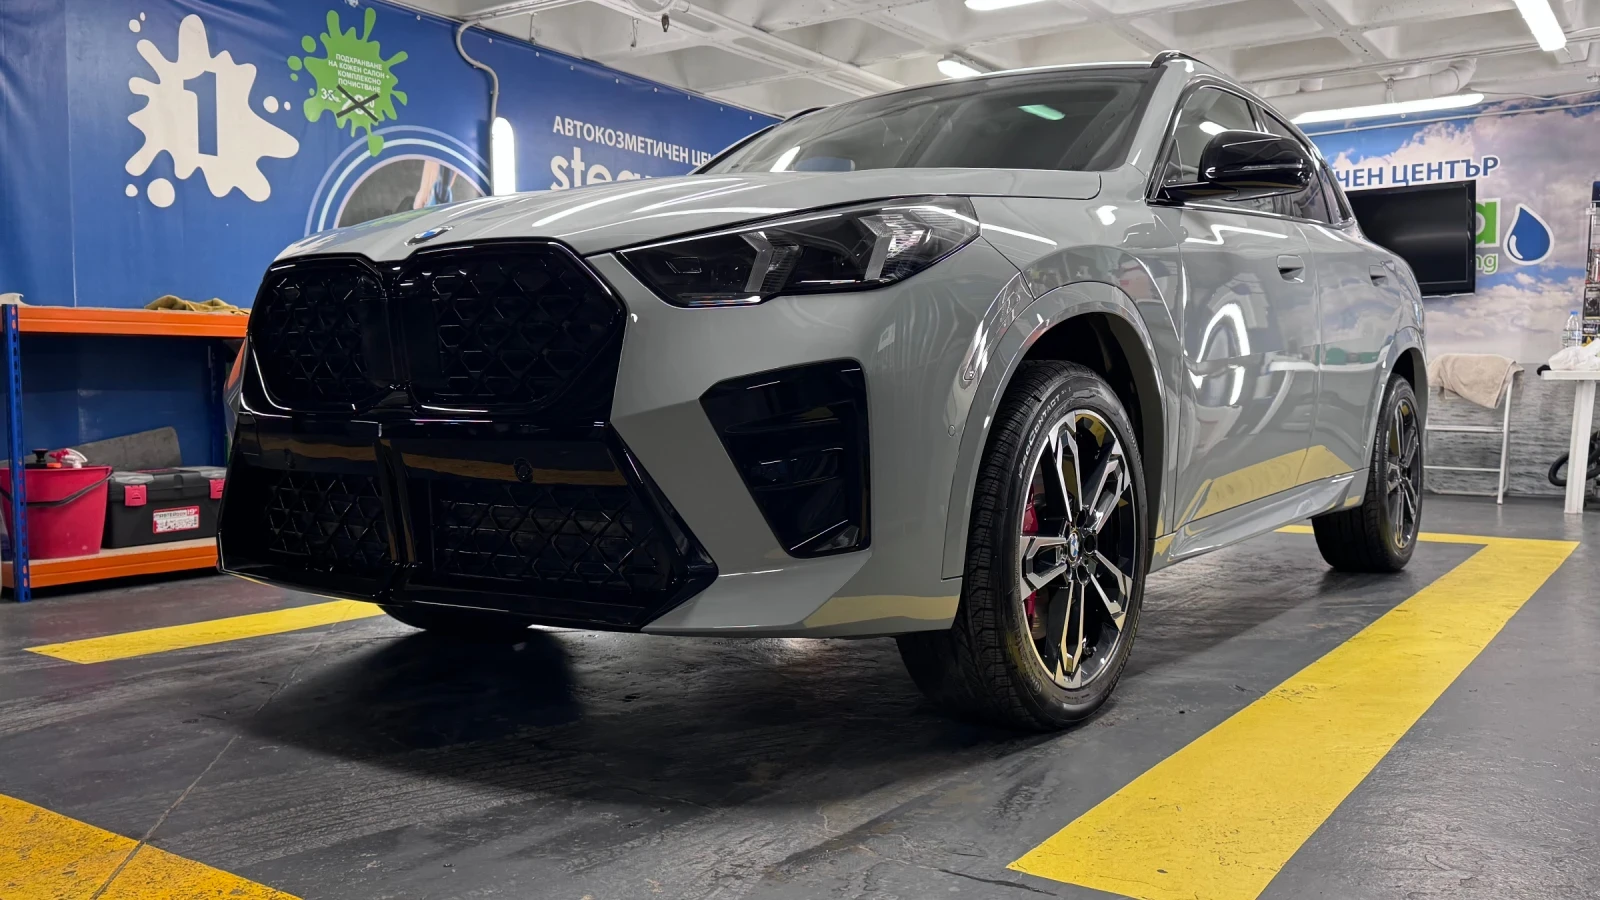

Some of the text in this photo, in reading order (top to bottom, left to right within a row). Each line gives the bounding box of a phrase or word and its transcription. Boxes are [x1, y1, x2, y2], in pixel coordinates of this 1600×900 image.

[328, 60, 338, 68] НА
[339, 62, 362, 73] КОЖЕН
[363, 68, 385, 79] САЛОН
[336, 53, 382, 70] ПОДХРАНВАНЕ
[337, 70, 381, 86] КОМПЛЕКСНО
[338, 78, 381, 93] ПОЧИСТВАНЕ
[183, 70, 218, 157] 1
[553, 115, 689, 164] АВТОКОЗМЕТИЧЕН
[1392, 157, 1499, 186] ЦЕНТЪР
